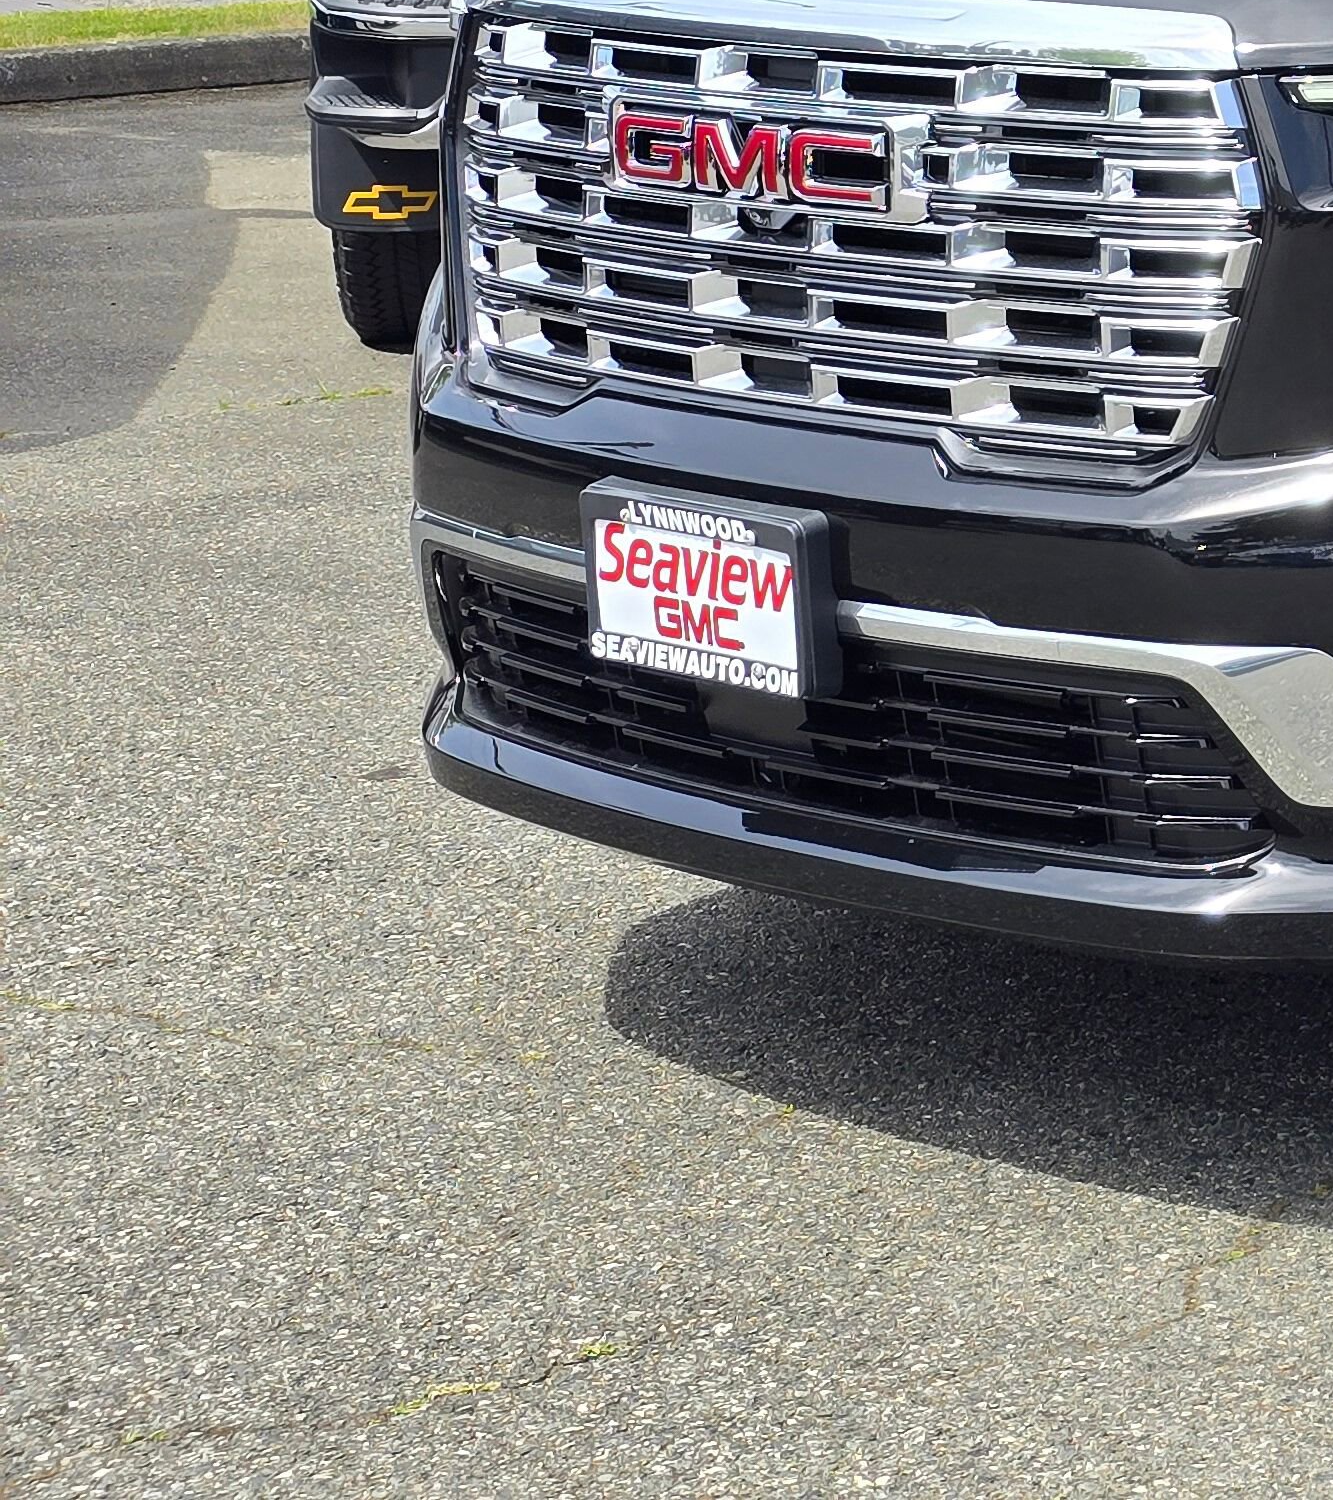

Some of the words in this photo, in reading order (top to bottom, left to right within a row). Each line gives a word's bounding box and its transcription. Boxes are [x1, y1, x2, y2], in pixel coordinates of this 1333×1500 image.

[614, 112, 888, 213] GMC
[627, 500, 749, 543] LYNNWOOD
[599, 522, 794, 613] Seaview
[653, 594, 745, 651] GMC
[590, 631, 799, 697] SEAVIEWAUTO.COM
